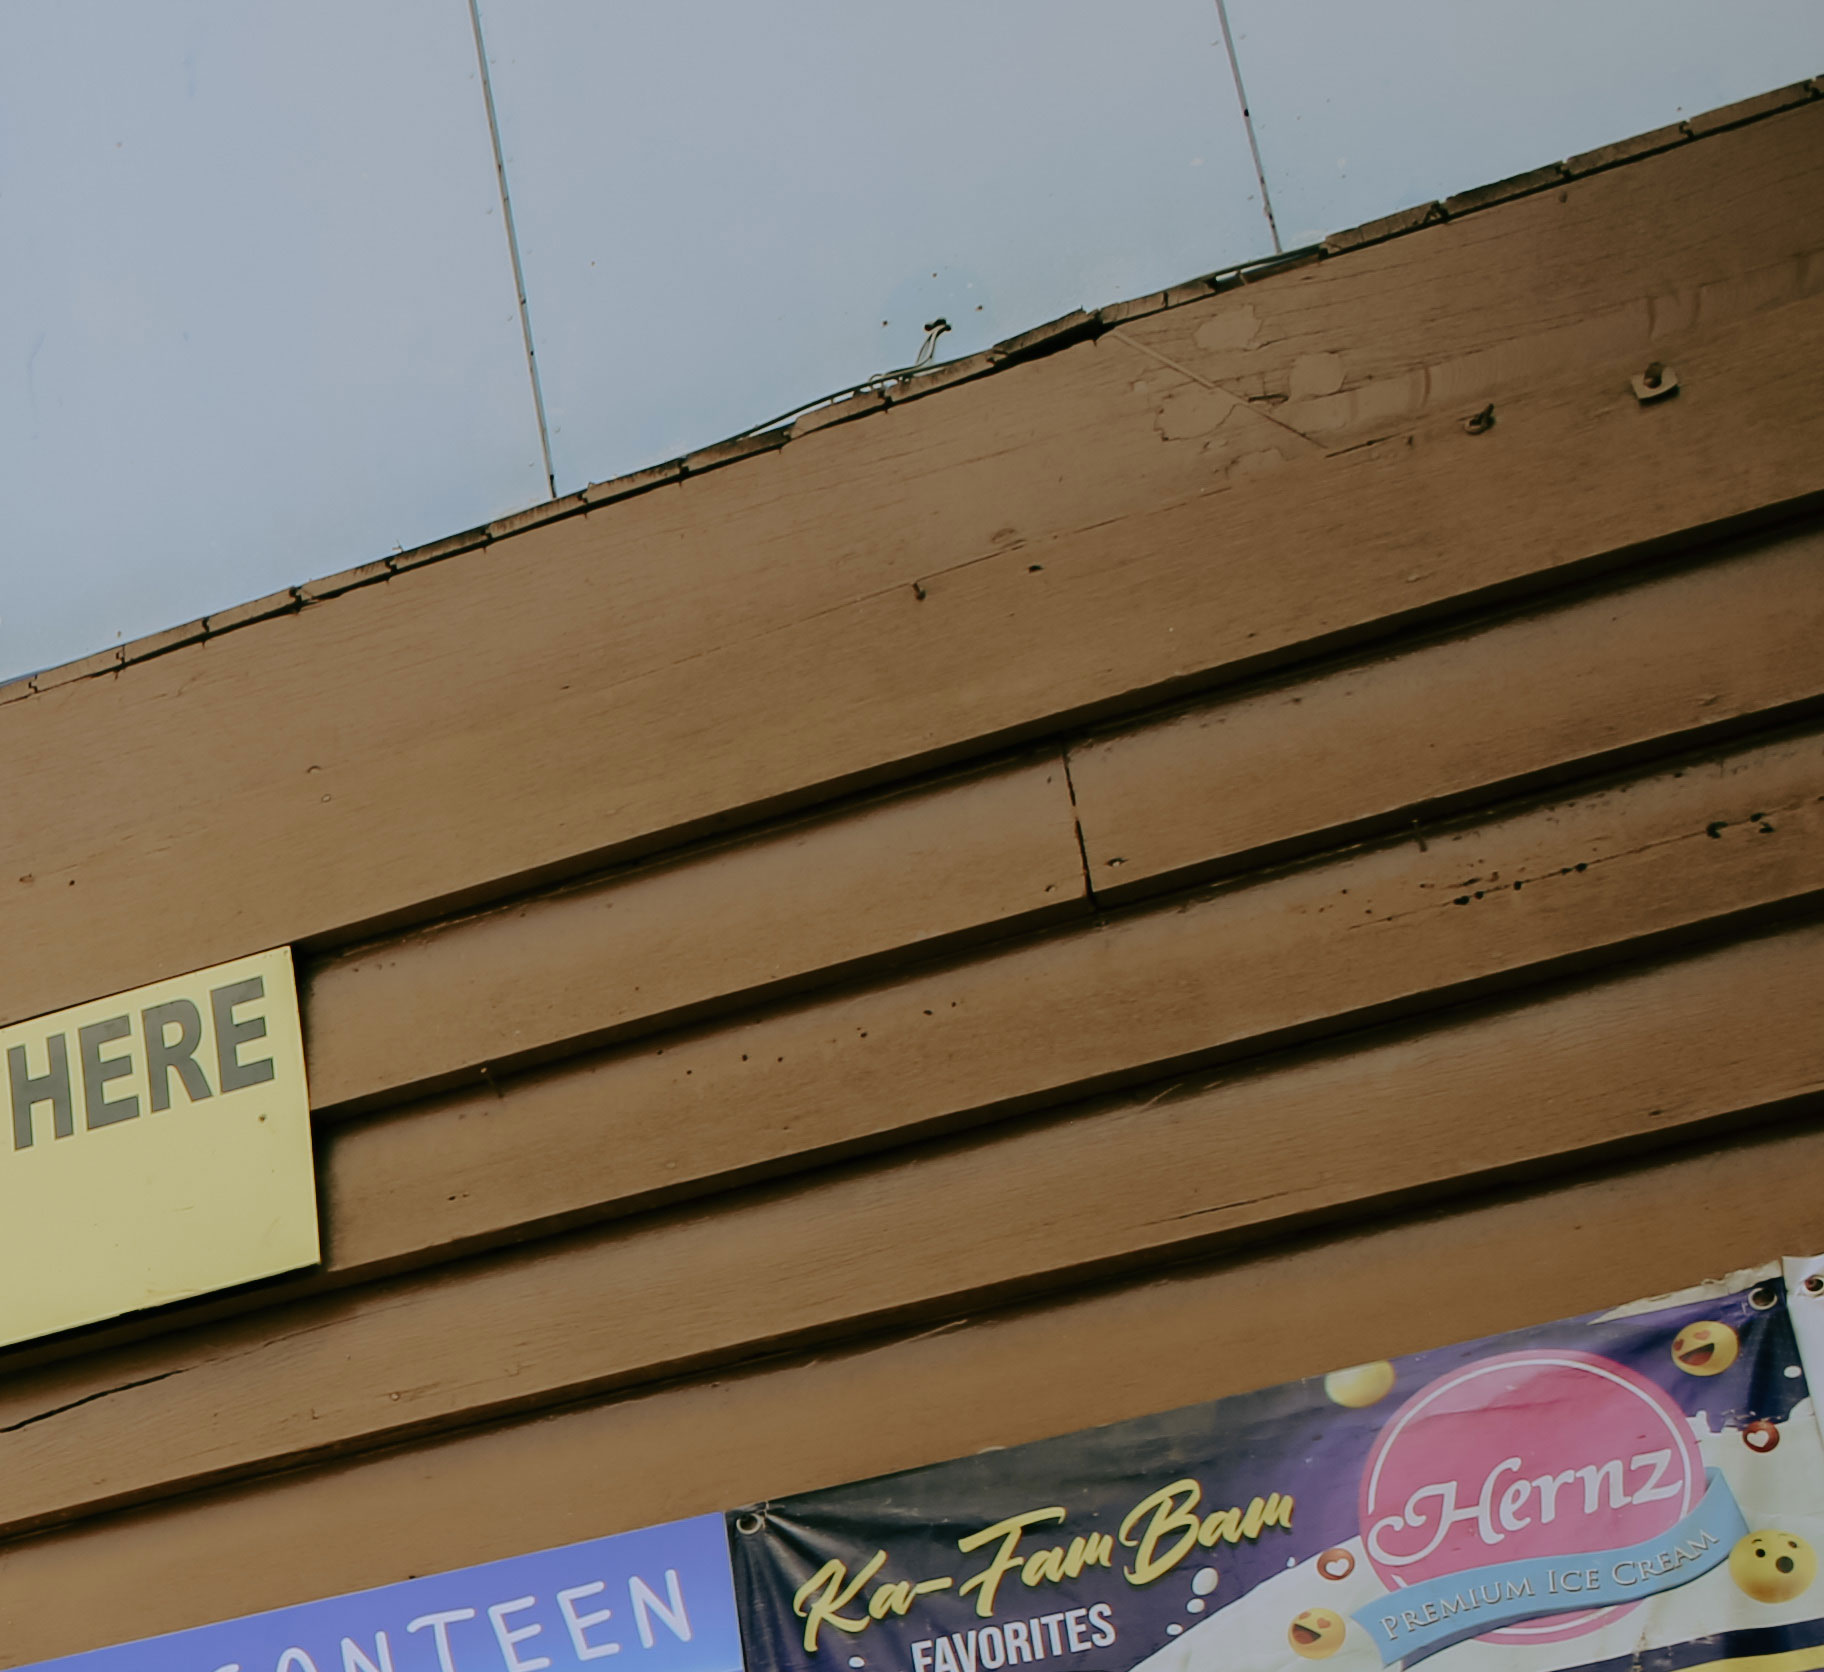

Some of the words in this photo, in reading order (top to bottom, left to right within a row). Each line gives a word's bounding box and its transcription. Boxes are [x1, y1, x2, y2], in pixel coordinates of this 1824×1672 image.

[6, 974, 275, 1153] HERE
[1118, 1478, 1294, 1586] Bam
[1367, 1449, 1683, 1566] Hernz
[1379, 1577, 1535, 1641] PREMIUM
[1611, 1529, 1719, 1586] CREAM
